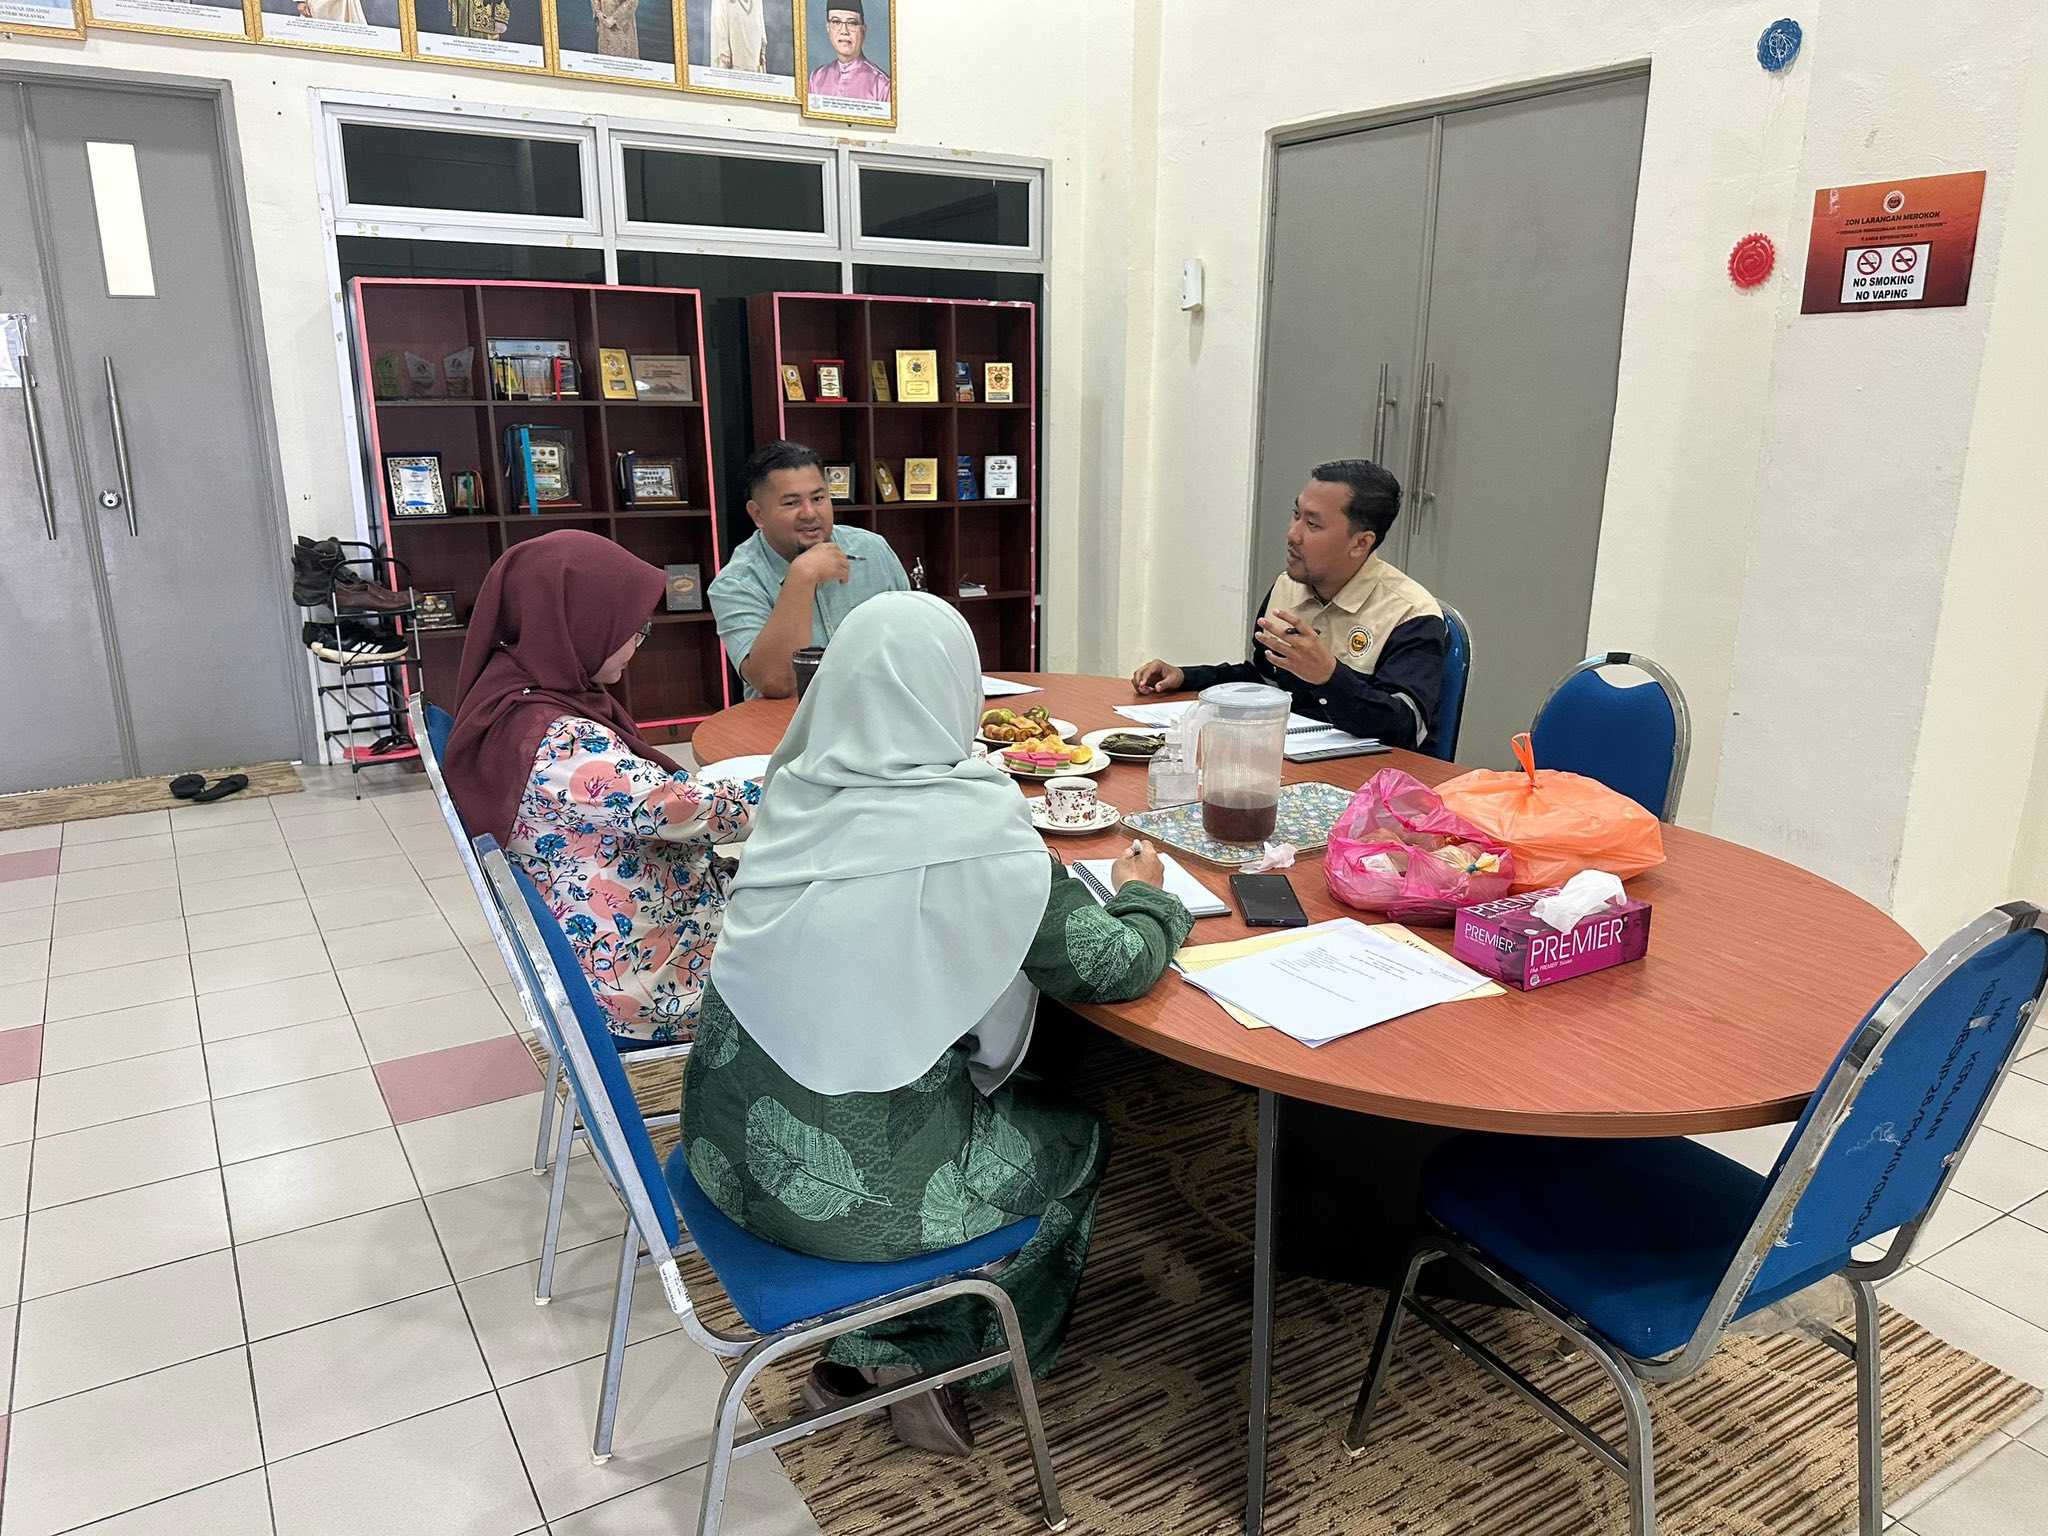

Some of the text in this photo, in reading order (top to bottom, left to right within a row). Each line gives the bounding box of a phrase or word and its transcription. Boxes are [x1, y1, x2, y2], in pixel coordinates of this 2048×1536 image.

[1861, 214, 1901, 225] LARANGAN
[1903, 211, 1941, 221] MEROKOK
[1853, 275, 1915, 287] NO SMOKING
[1855, 289, 1908, 300] NO VAPING
[1465, 923, 1513, 953] PREMIER
[1531, 918, 1623, 967] PREMIER
[1925, 997, 2011, 1140] HAK KERAJAAN
